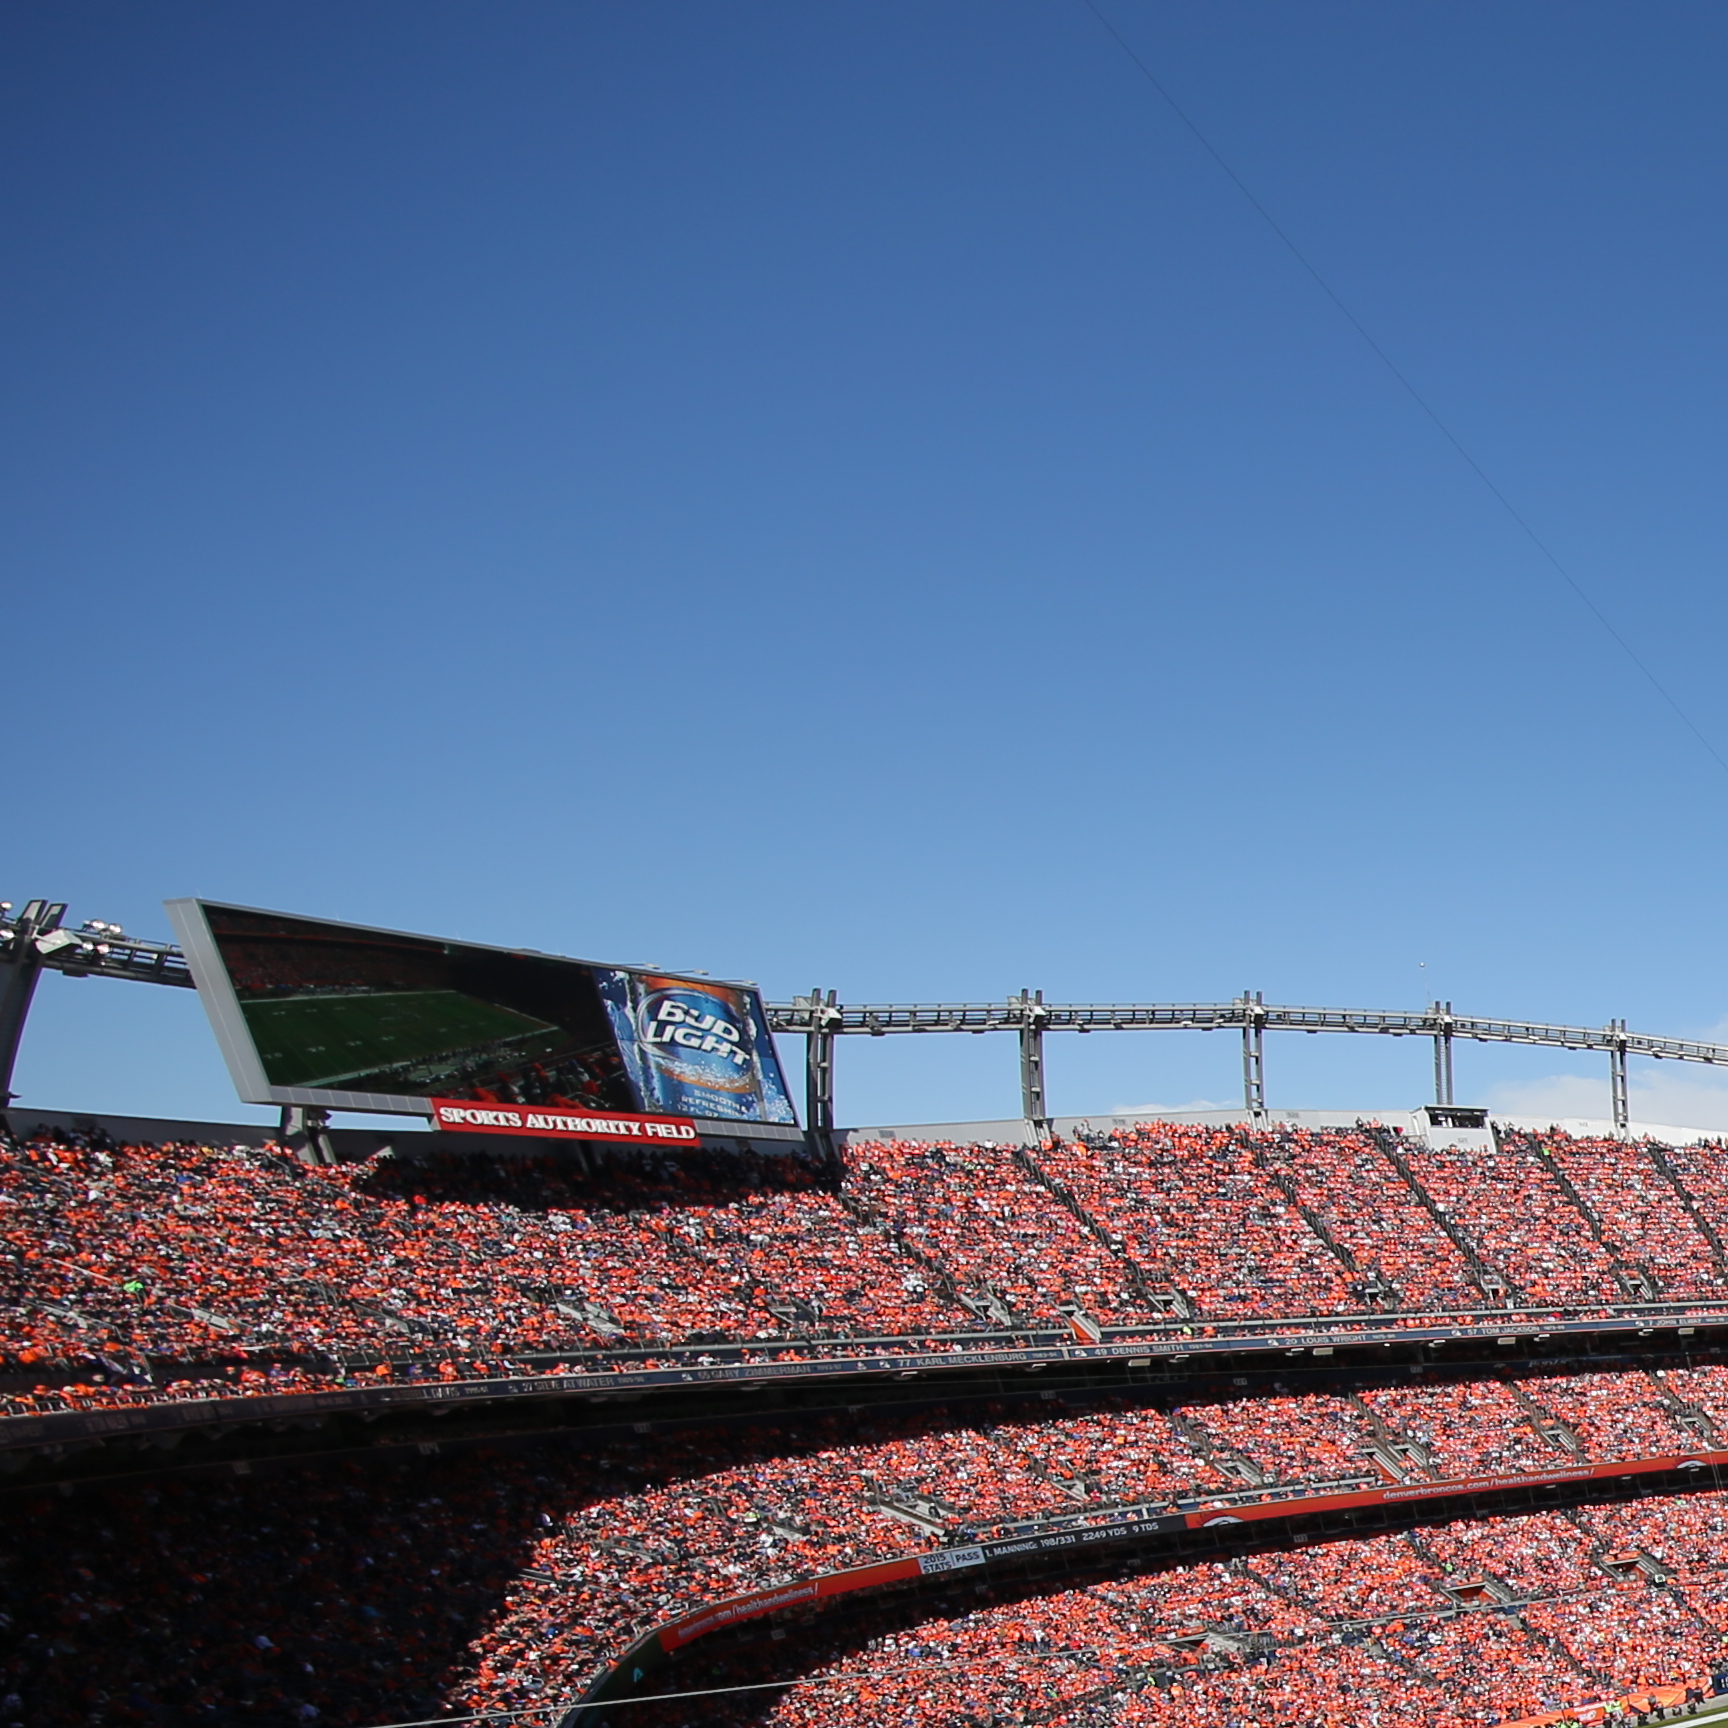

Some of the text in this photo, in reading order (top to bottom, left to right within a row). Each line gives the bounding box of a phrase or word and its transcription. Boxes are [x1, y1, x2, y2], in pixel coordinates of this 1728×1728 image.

[658, 1000, 740, 1043] BUD
[646, 1021, 751, 1066] LIGHT
[439, 1106, 696, 1140] SPORTS AUTHORITY FIELD
[1481, 1326, 1499, 1335] TOM
[1500, 1325, 1540, 1334] JACKSON
[1656, 1319, 1676, 1327] JOHN
[1284, 1334, 1367, 1345] 20 LOUIS WRIGHT
[1094, 1343, 1184, 1356] 49 DENNIS SMITH
[898, 1357, 911, 1367] 77
[917, 1355, 946, 1366] KARL
[948, 1352, 1027, 1365] MECKLENBURG
[711, 1368, 740, 1380] GARY
[744, 1364, 811, 1378] ZIMMERMAN
[534, 1379, 561, 1392] STEVE
[563, 1376, 615, 1390] ATWATER
[1383, 1468, 1595, 1500] denverbroncos.com/healthandwellness/
[993, 1542, 1038, 1556] MANNING:
[1082, 1530, 1106, 1542] 2249
[1108, 1527, 1127, 1538] YDS
[1132, 1524, 1139, 1534] 9
[1141, 1522, 1159, 1533] TDS
[924, 1554, 947, 1564] 2015
[955, 1551, 981, 1562] PASS
[922, 1563, 951, 1575] STATS
